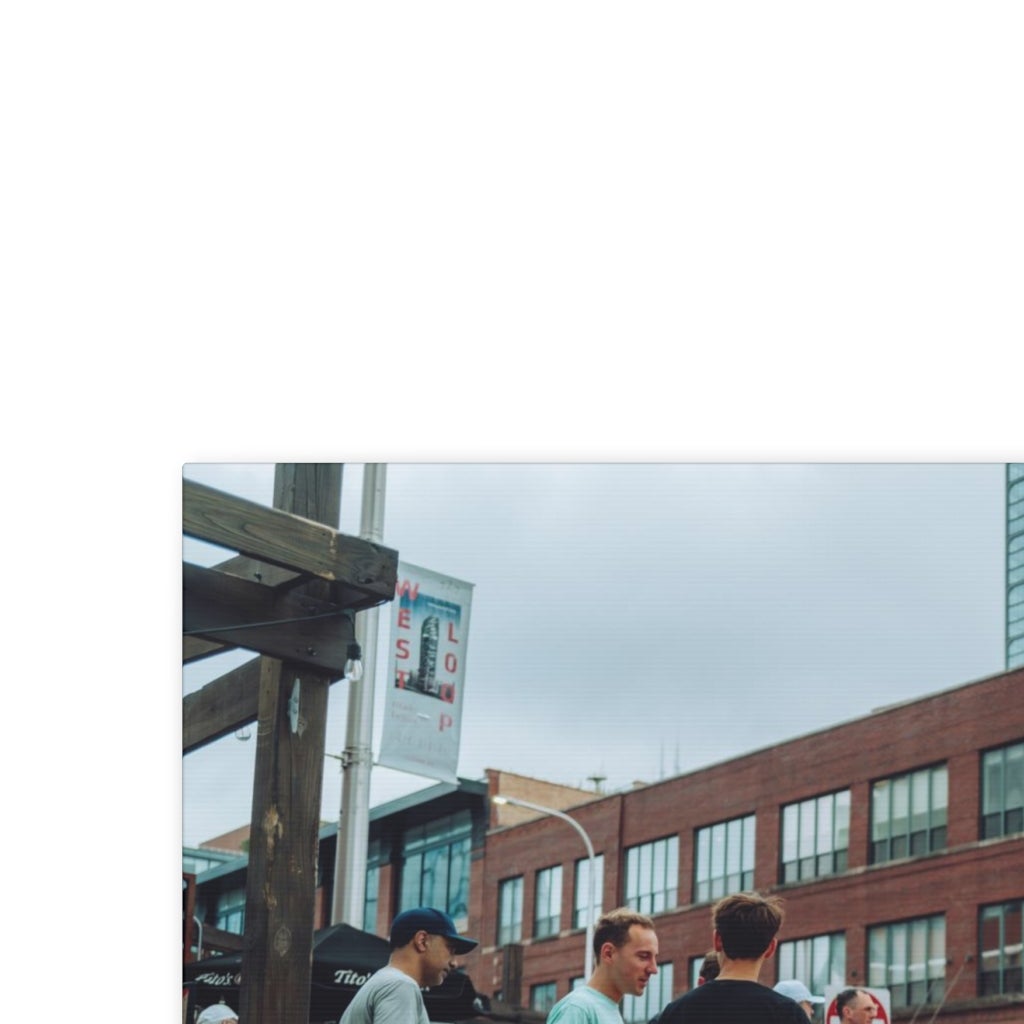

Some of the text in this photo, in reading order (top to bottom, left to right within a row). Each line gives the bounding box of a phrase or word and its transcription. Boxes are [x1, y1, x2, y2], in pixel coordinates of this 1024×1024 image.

[395, 579, 419, 690] WEST
[439, 621, 459, 732] LOOP
[334, 969, 371, 986] Tito'
